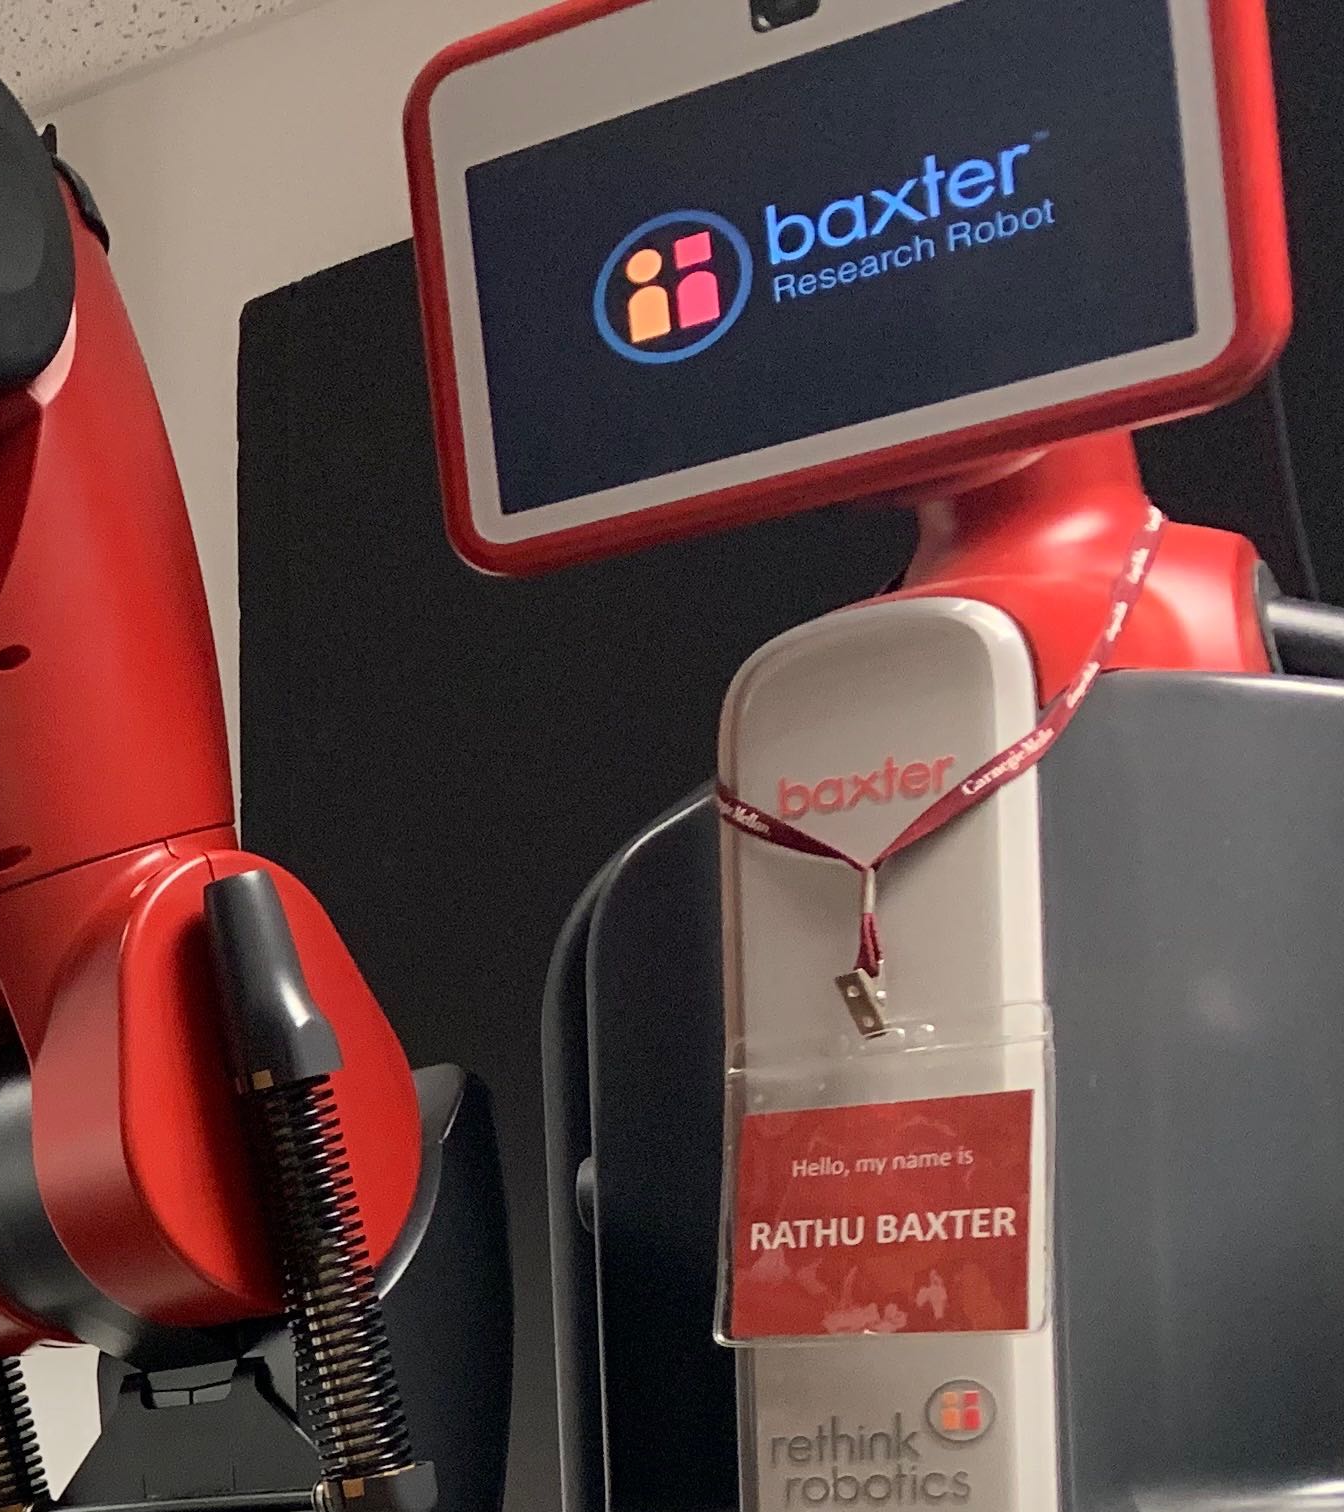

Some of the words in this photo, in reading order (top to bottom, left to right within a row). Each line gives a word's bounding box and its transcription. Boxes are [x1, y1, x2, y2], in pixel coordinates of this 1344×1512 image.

[764, 142, 1031, 266] baxter
[773, 233, 936, 304] Research
[947, 198, 1056, 252] Robot
[778, 755, 956, 819] baxter
[791, 1156, 851, 1178] Hello,
[855, 1157, 888, 1176] my
[891, 1151, 952, 1171] name
[957, 1146, 975, 1166] is
[750, 1215, 866, 1251] RATHU
[876, 1206, 1018, 1244] BAXTER
[770, 1411, 921, 1468] rethink
[784, 1464, 972, 1508] robotics
